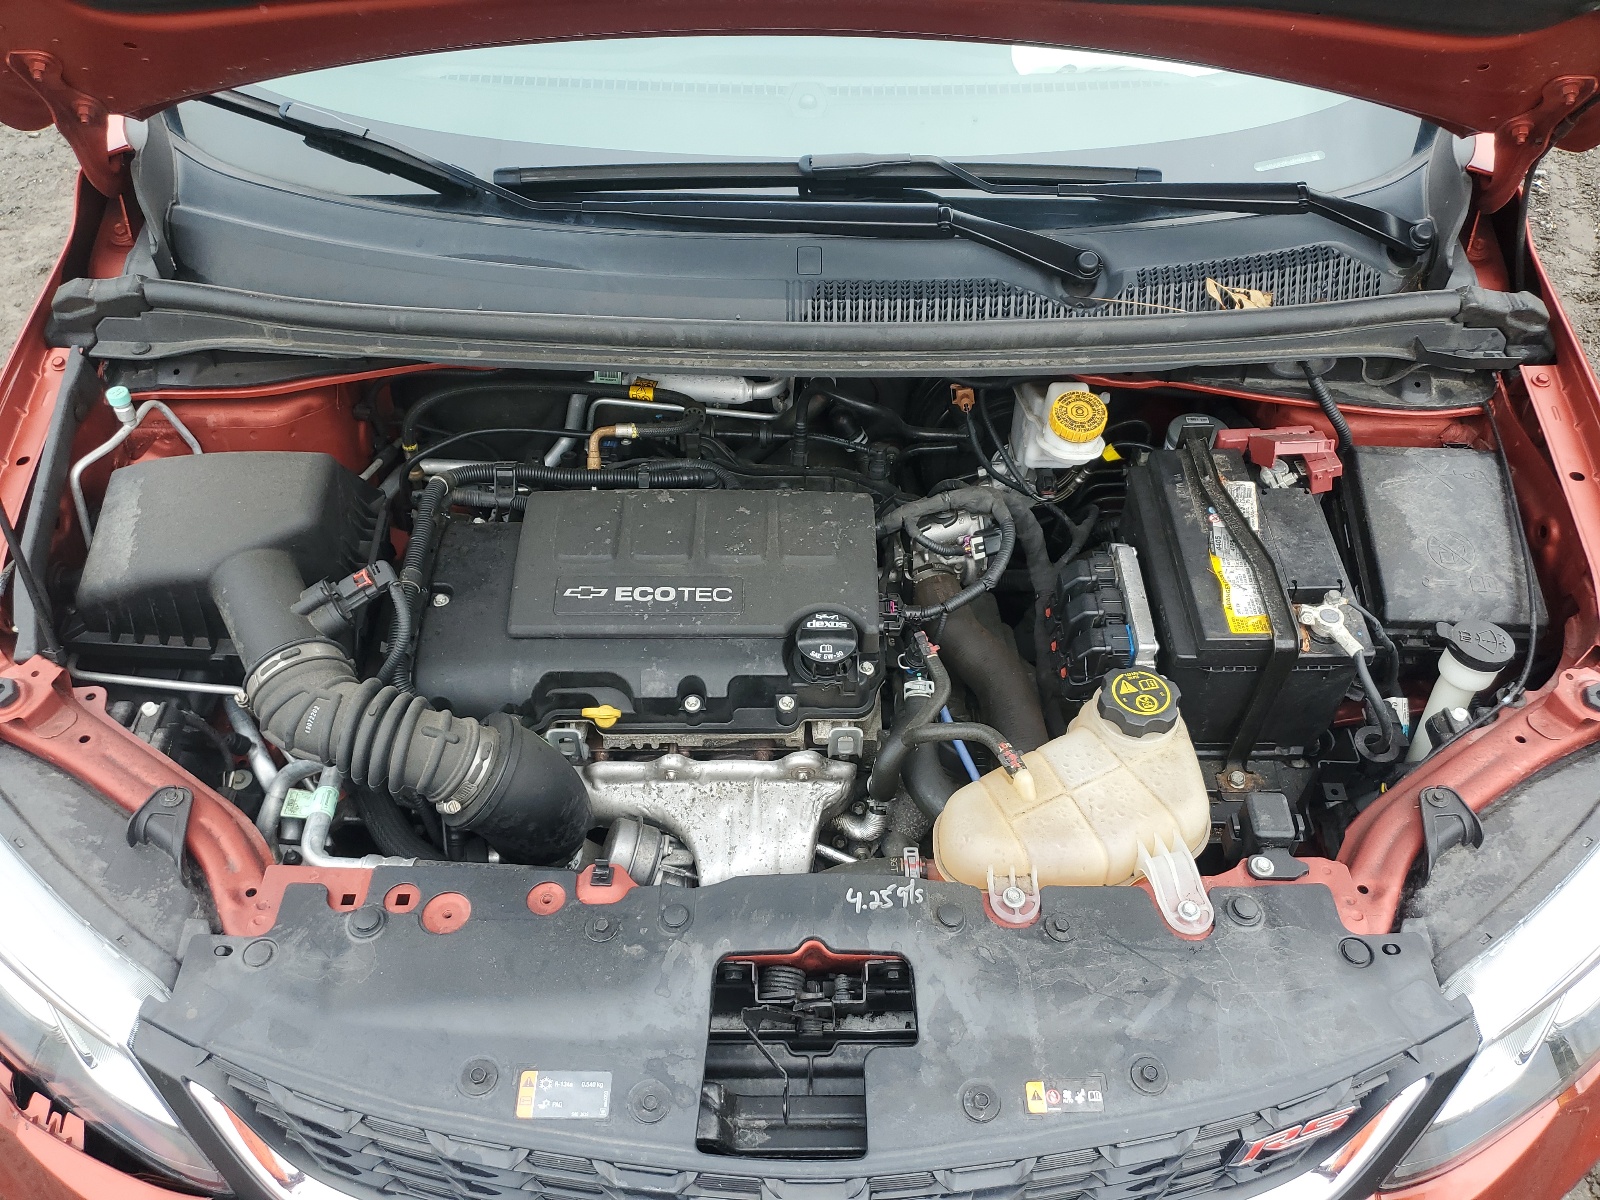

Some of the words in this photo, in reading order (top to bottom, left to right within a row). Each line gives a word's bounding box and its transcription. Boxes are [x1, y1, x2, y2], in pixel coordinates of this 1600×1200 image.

[614, 586, 733, 602] ECOTEC
[806, 619, 848, 628] dexos
[846, 883, 897, 914] 4.25
[1233, 1106, 1356, 1166] RS
